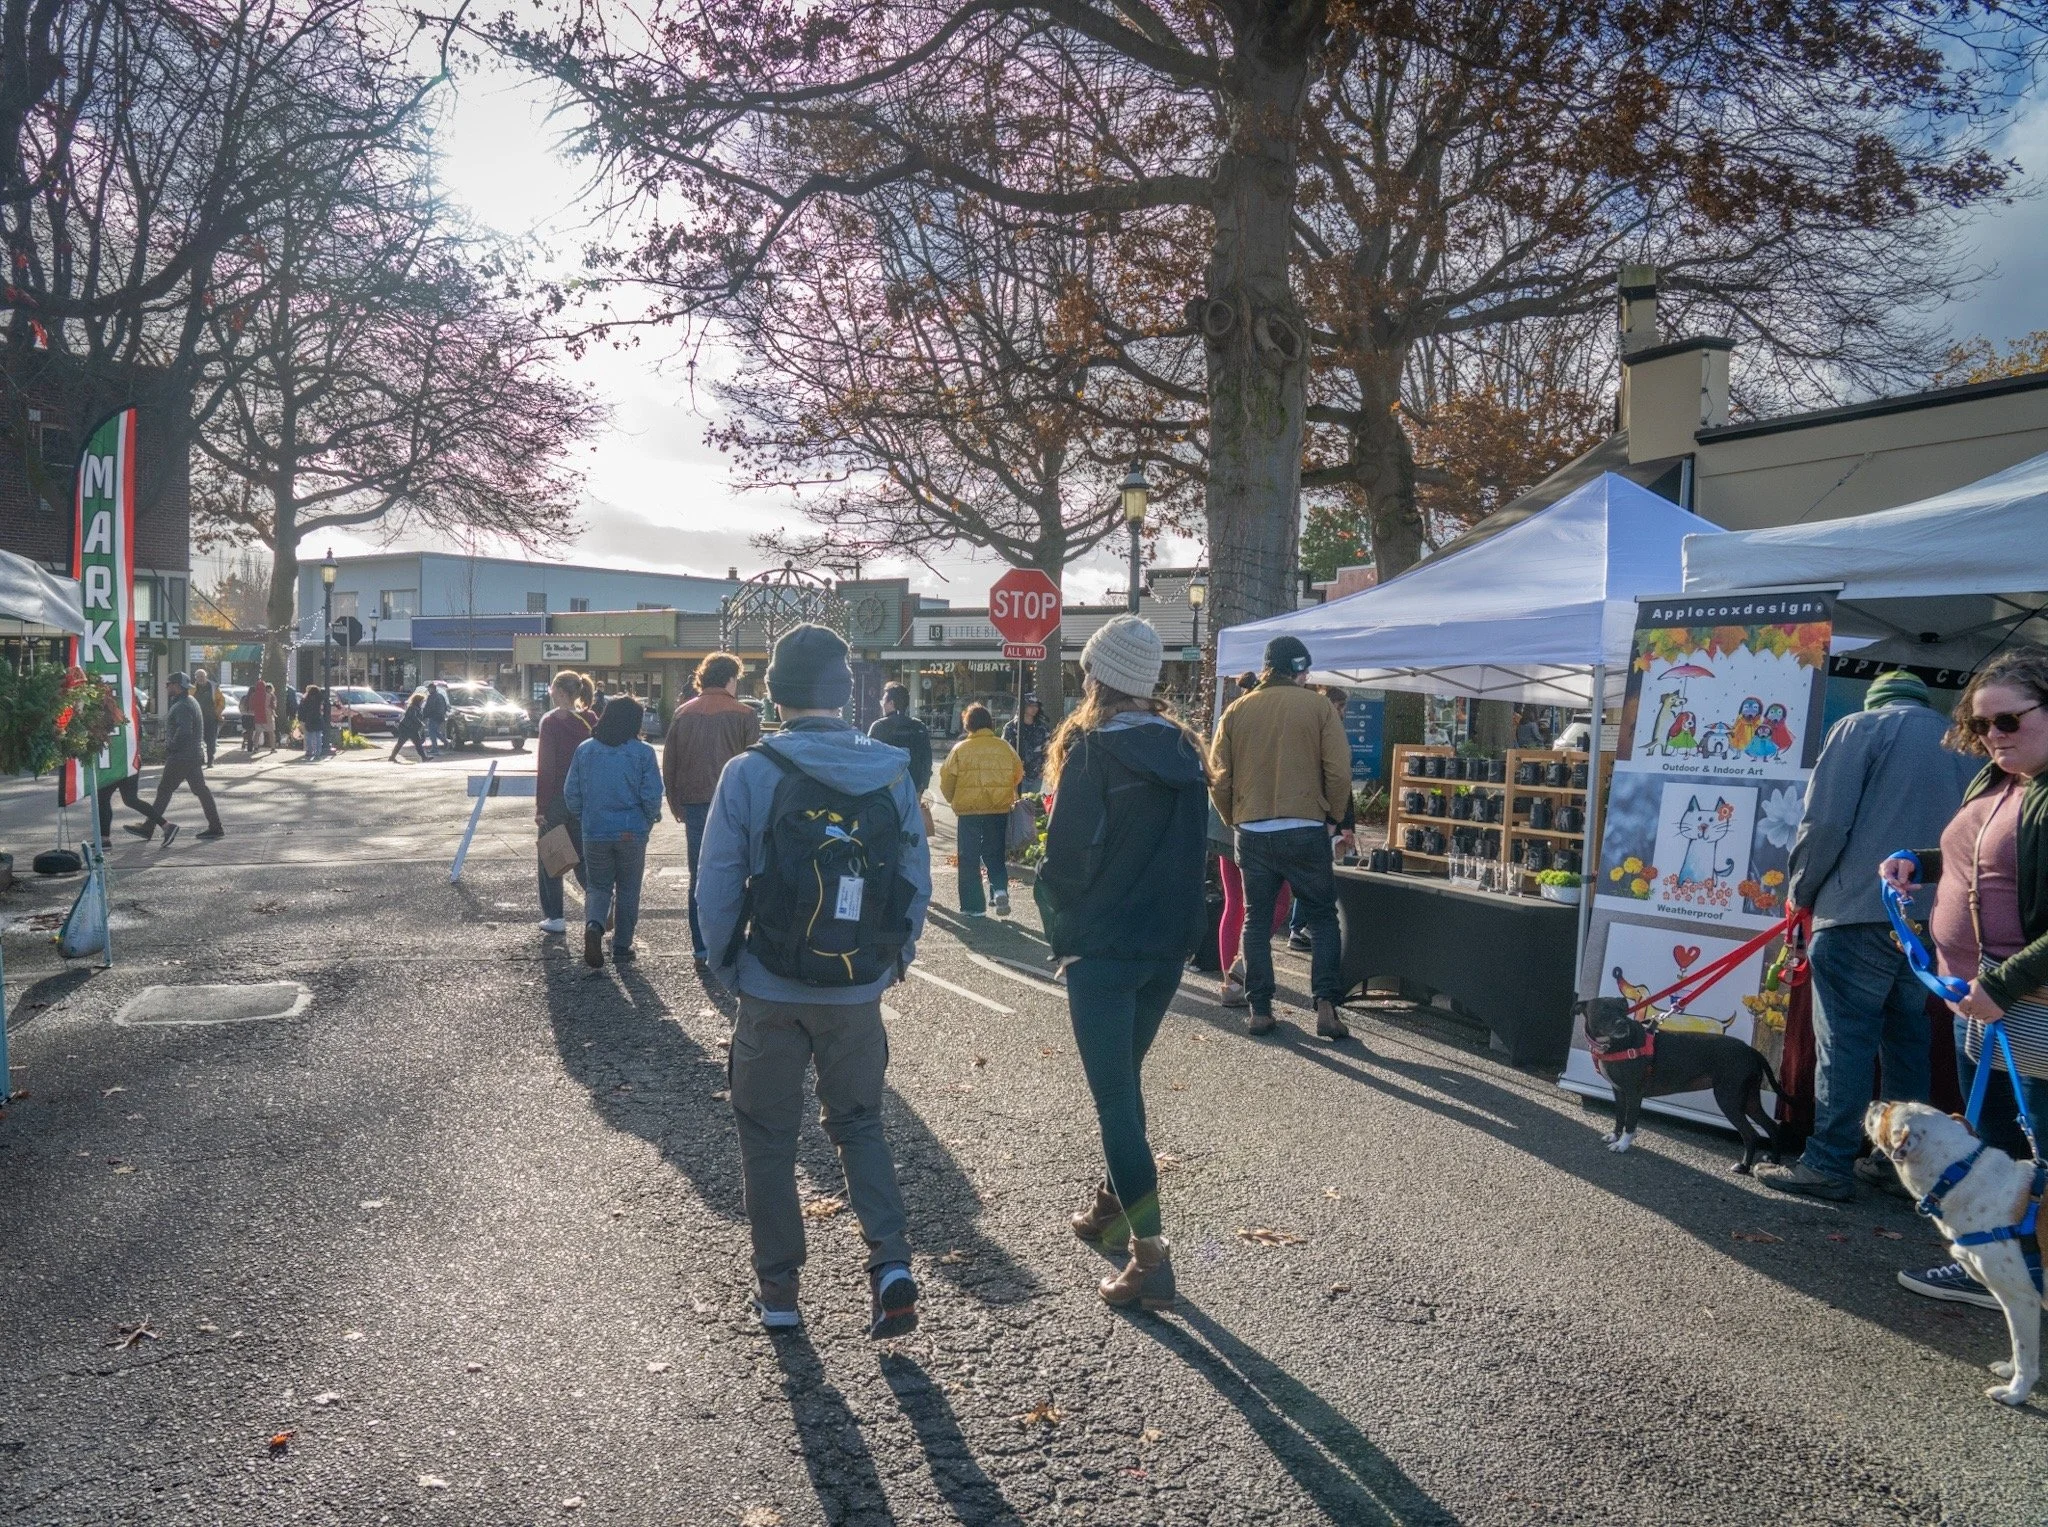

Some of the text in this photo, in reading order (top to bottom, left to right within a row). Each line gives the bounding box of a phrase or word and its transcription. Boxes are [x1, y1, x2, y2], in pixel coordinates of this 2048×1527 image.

[993, 589, 1057, 619] STOP
[948, 625, 980, 637] LITTLE
[1006, 647, 1042, 657] ALL WAY
[854, 734, 872, 746] HH
[1662, 763, 1764, 776] Outdoor & Indoor Art
[1656, 903, 1724, 920] Weatherproof
